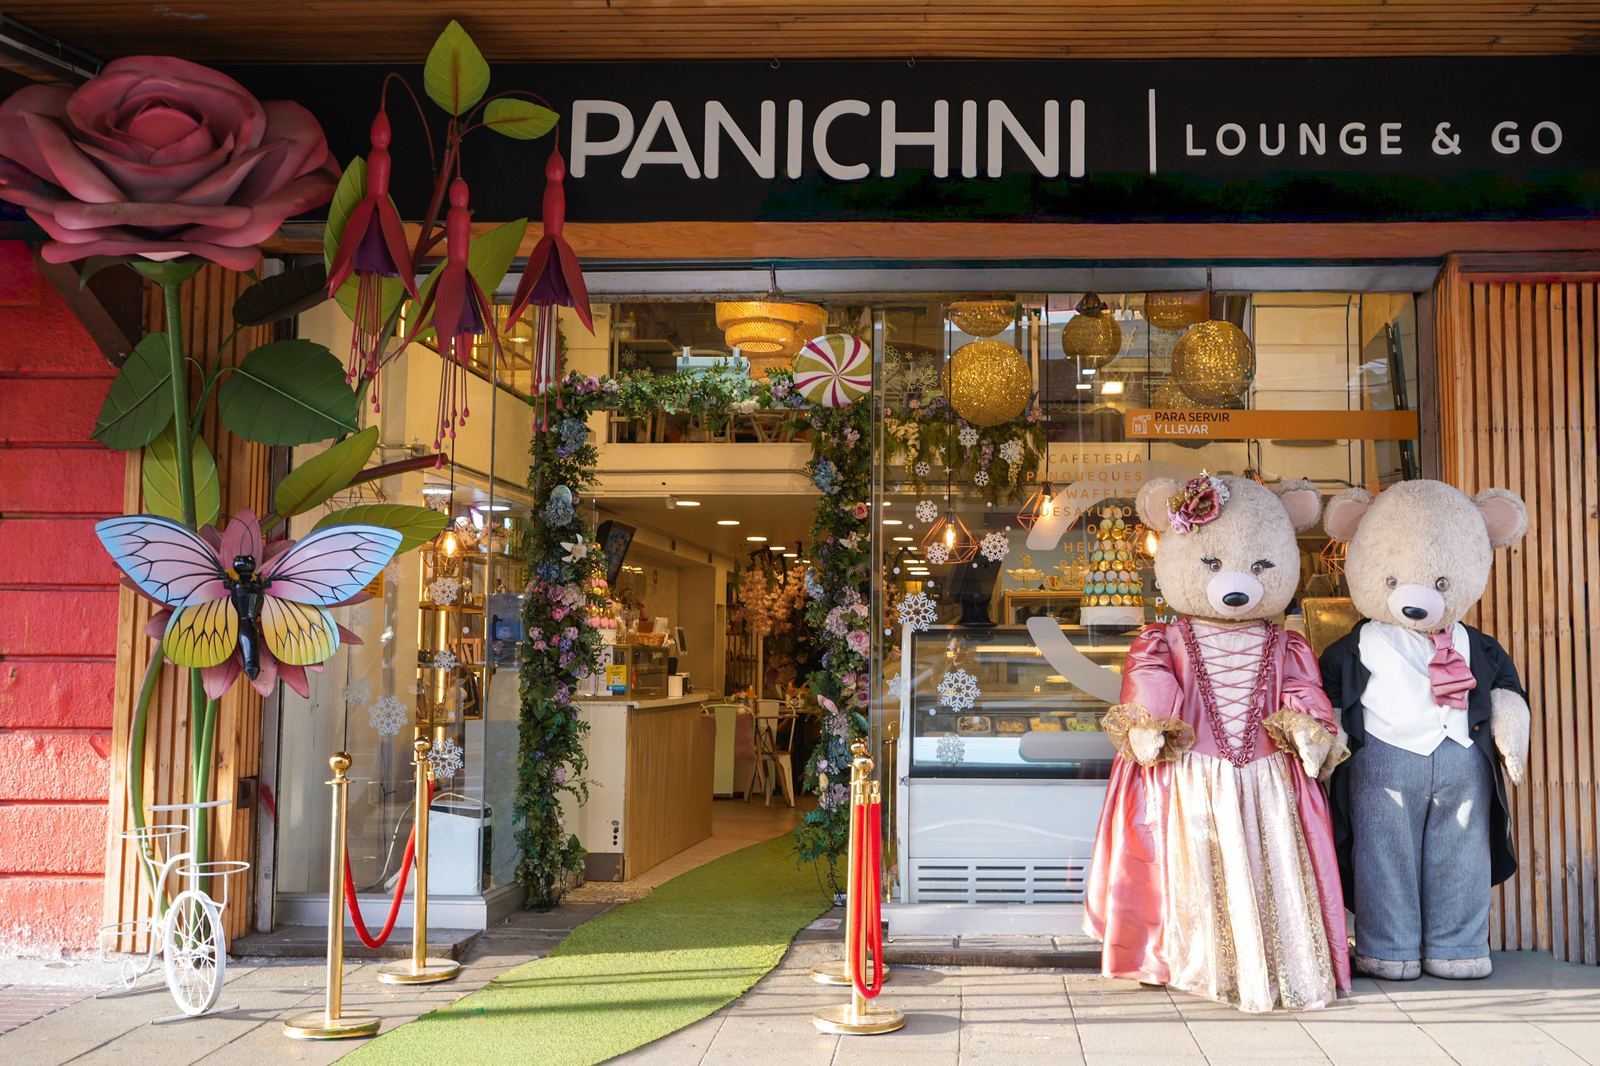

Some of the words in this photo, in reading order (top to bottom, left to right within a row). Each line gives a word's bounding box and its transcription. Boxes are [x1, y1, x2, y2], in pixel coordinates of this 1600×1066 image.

[569, 98, 1086, 181] PANICHINI
[1185, 122, 1403, 157] LOUNGE
[1431, 121, 1461, 156] &
[1491, 120, 1564, 155] GO
[1154, 411, 1186, 422] PARA
[1188, 411, 1230, 423] SERVIR
[1154, 424, 1162, 434] Y
[1164, 424, 1209, 434] LLEVAR
[1048, 451, 1143, 464] CAFETERÍA
[1026, 471, 1143, 483] PANQUEQUES
